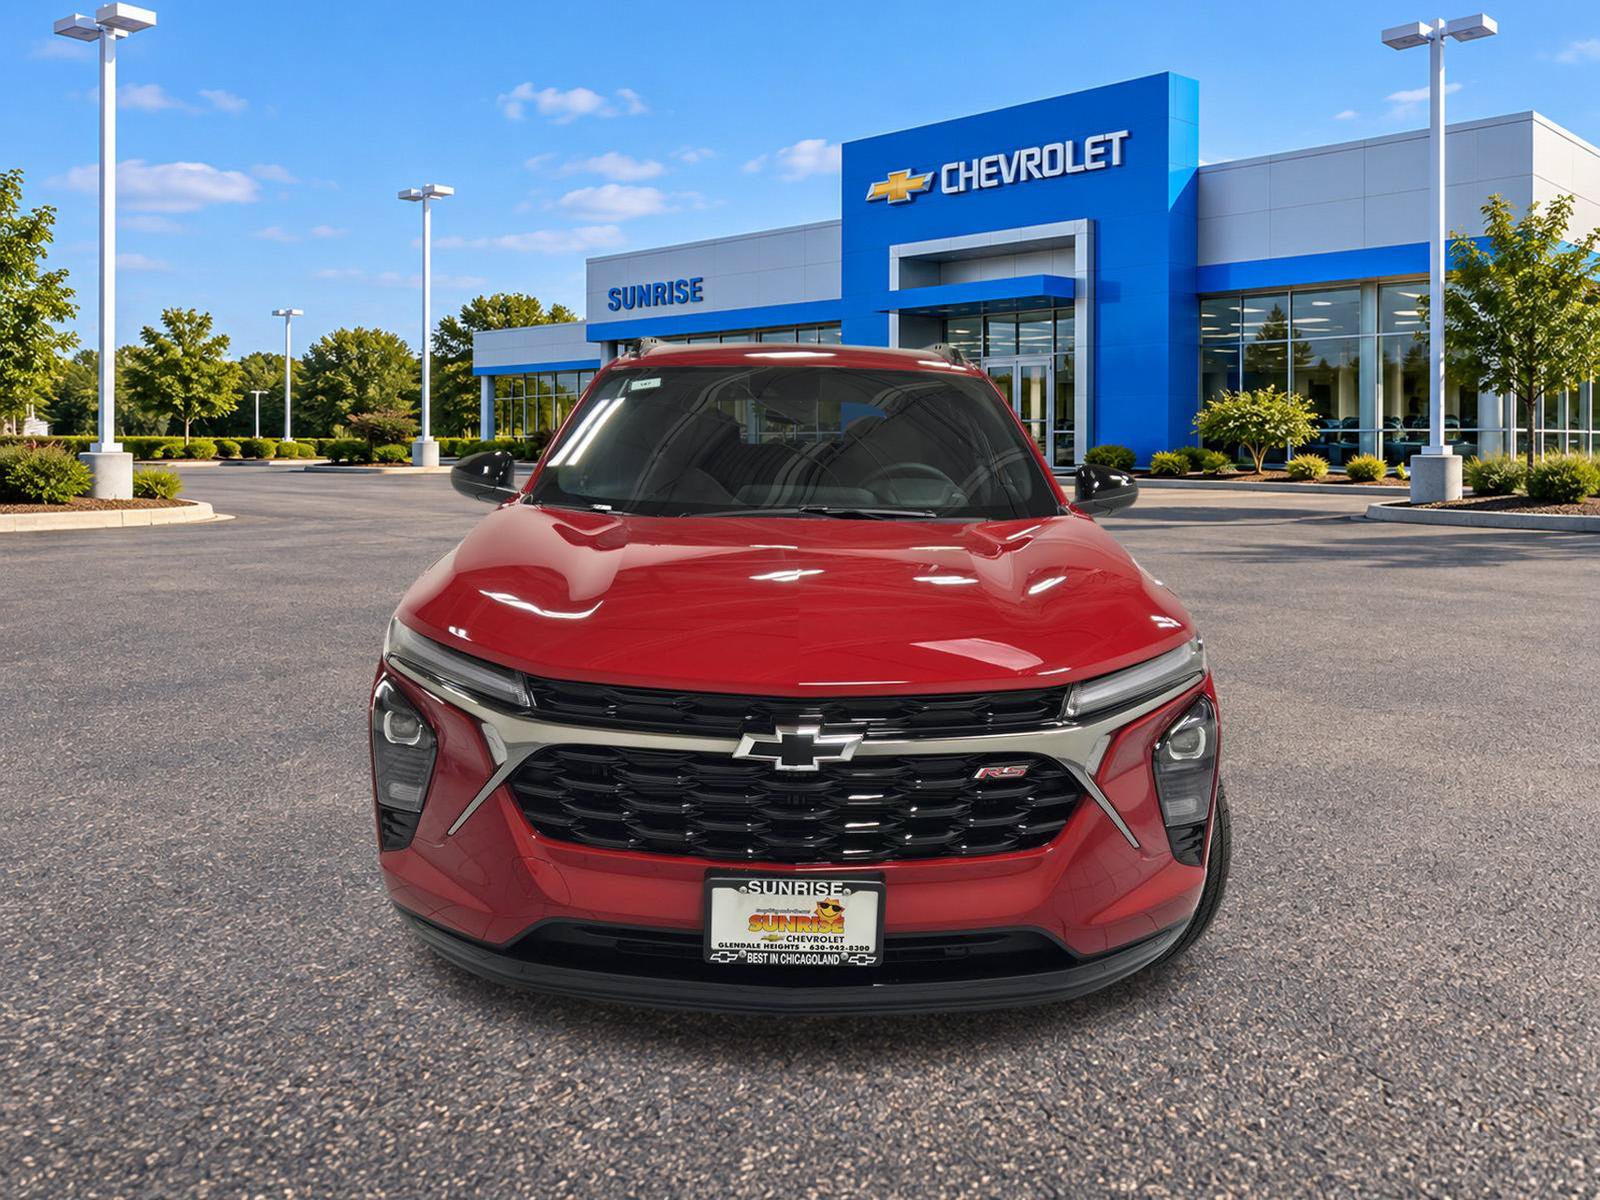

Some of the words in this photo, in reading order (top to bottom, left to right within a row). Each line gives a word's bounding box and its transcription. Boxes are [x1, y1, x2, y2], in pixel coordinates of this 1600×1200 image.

[941, 130, 1129, 194] CHEVROLET
[608, 277, 704, 312] SUNRISE
[974, 765, 1029, 779] RS
[748, 880, 844, 896] SUNRISE
[748, 914, 845, 933] SUNRISE
[718, 942, 761, 950] GLENDALE
[786, 935, 845, 943] CHEVROLET
[747, 952, 767, 964] BEST
[769, 953, 779, 964] IN
[780, 953, 840, 965] CHICAGOLAND
